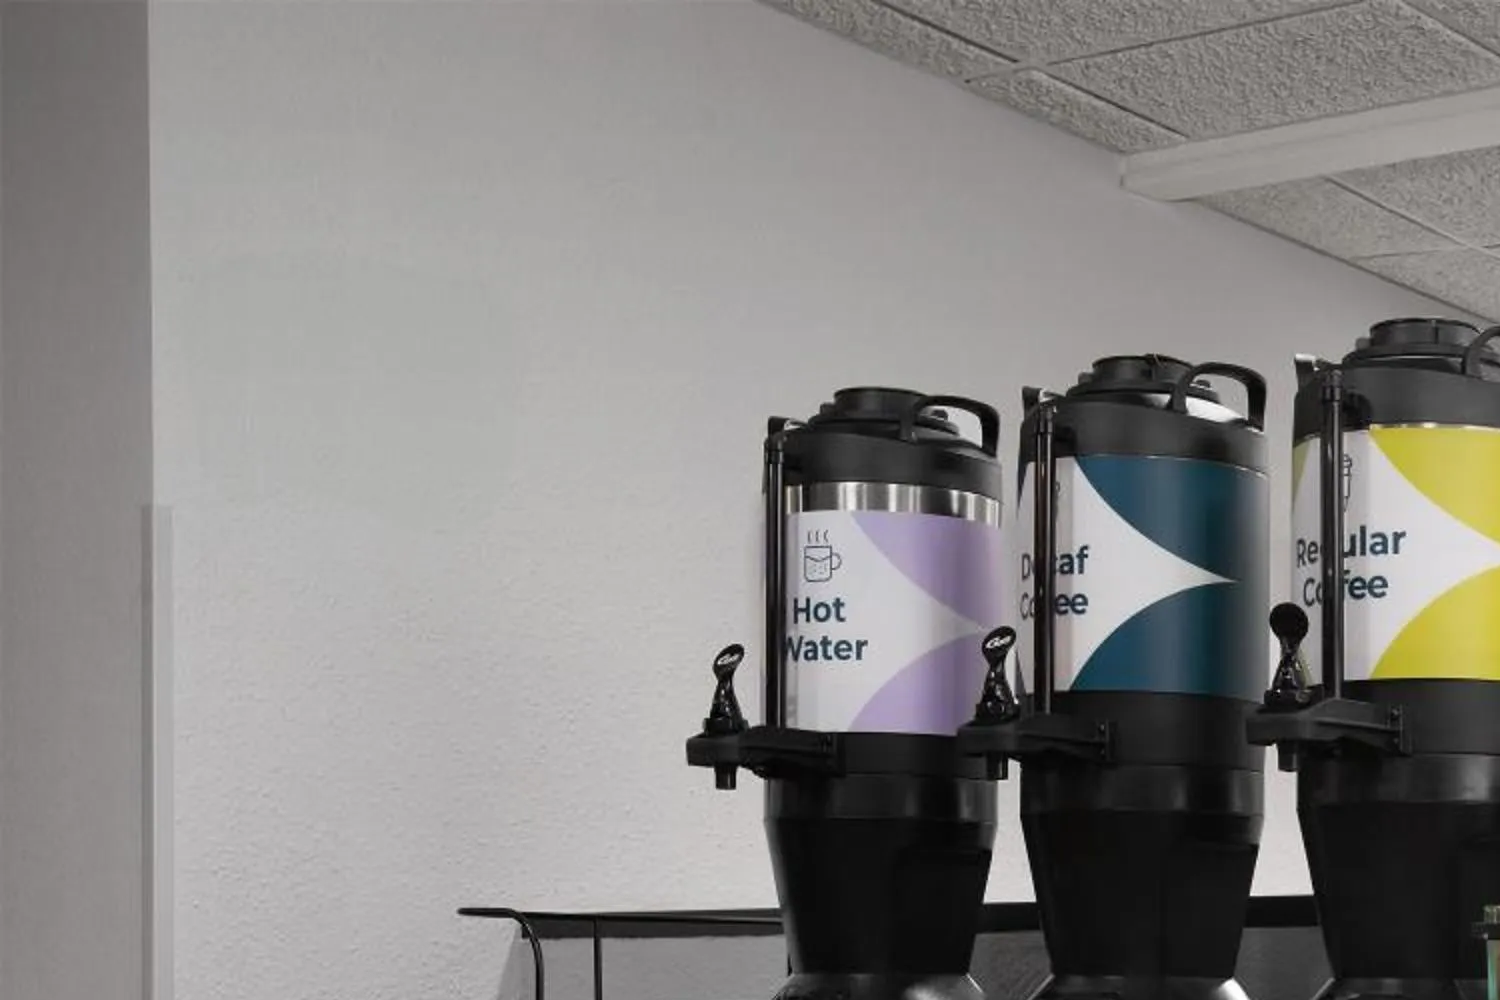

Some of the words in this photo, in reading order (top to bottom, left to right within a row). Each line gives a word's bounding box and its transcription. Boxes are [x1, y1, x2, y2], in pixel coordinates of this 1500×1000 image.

[1022, 545, 1089, 581] Daf
[1296, 525, 1406, 568] Reular
[1020, 592, 1089, 620] Cee
[1303, 569, 1389, 607] Coee
[793, 597, 847, 625] Hot
